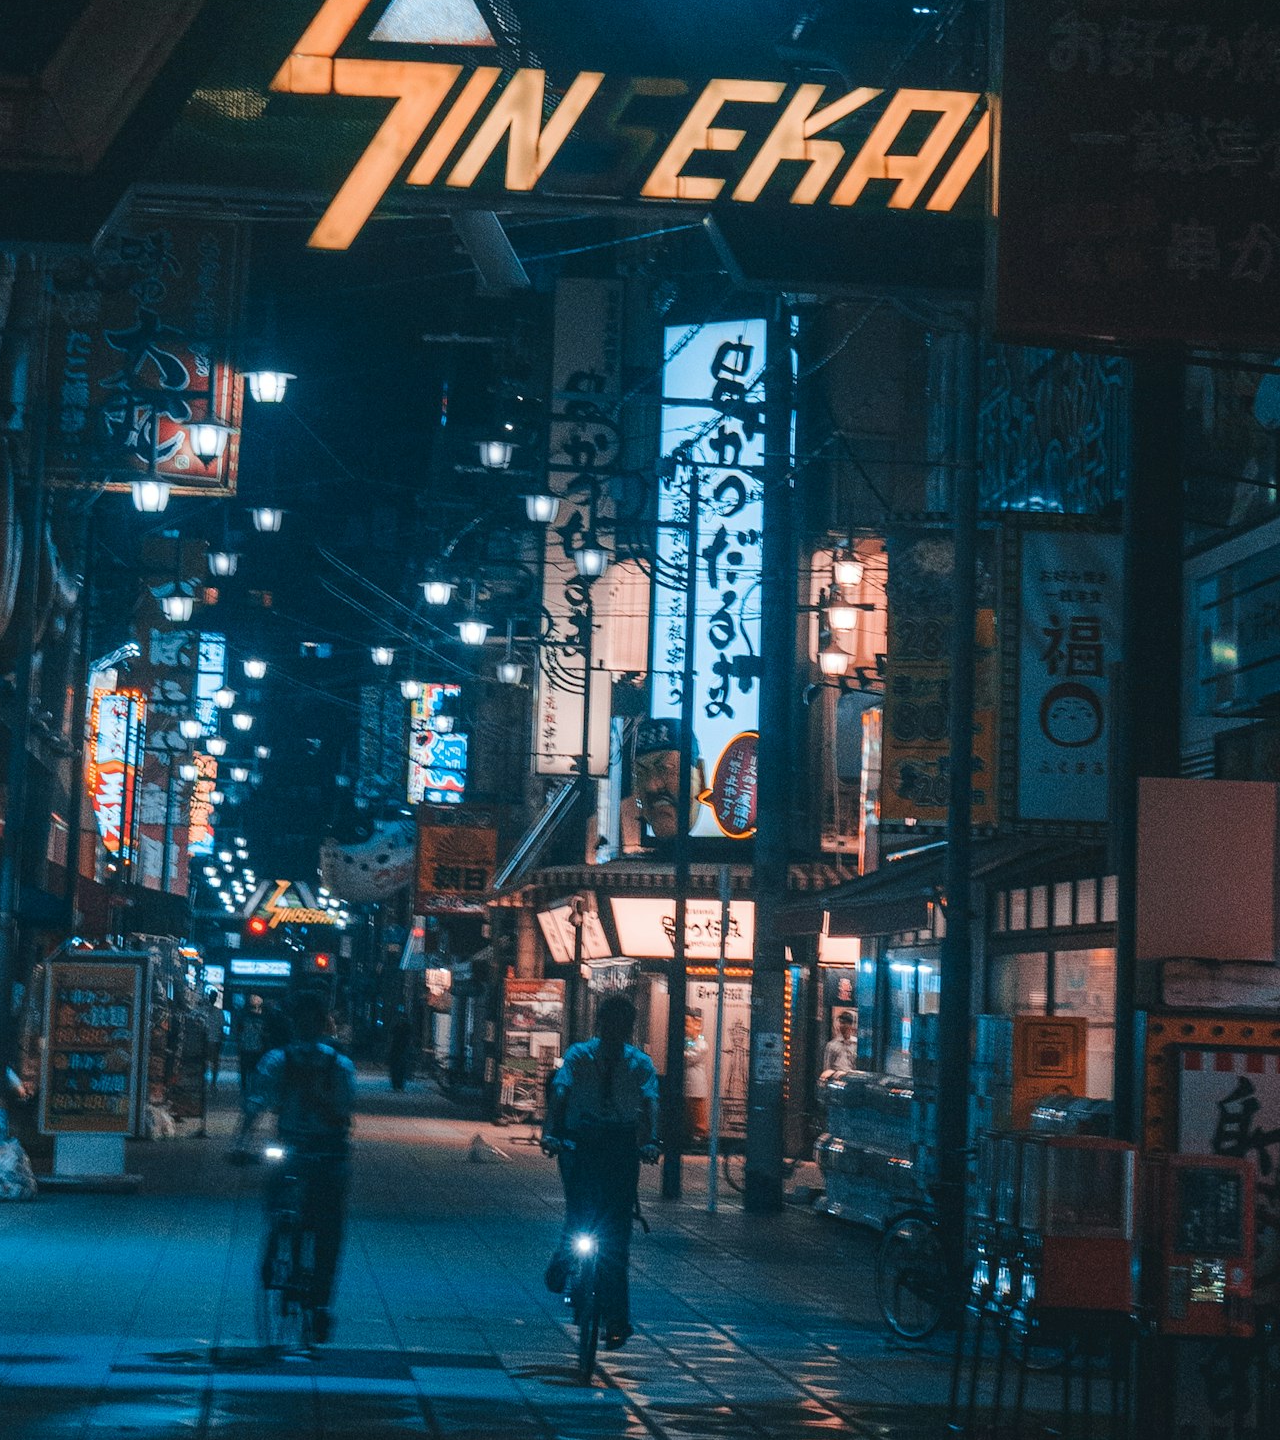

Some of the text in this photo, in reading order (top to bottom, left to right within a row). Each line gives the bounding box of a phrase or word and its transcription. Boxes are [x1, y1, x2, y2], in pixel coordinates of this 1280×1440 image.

[1042, 615, 1105, 678] 福
[1038, 759, 1106, 776] ふくまる
